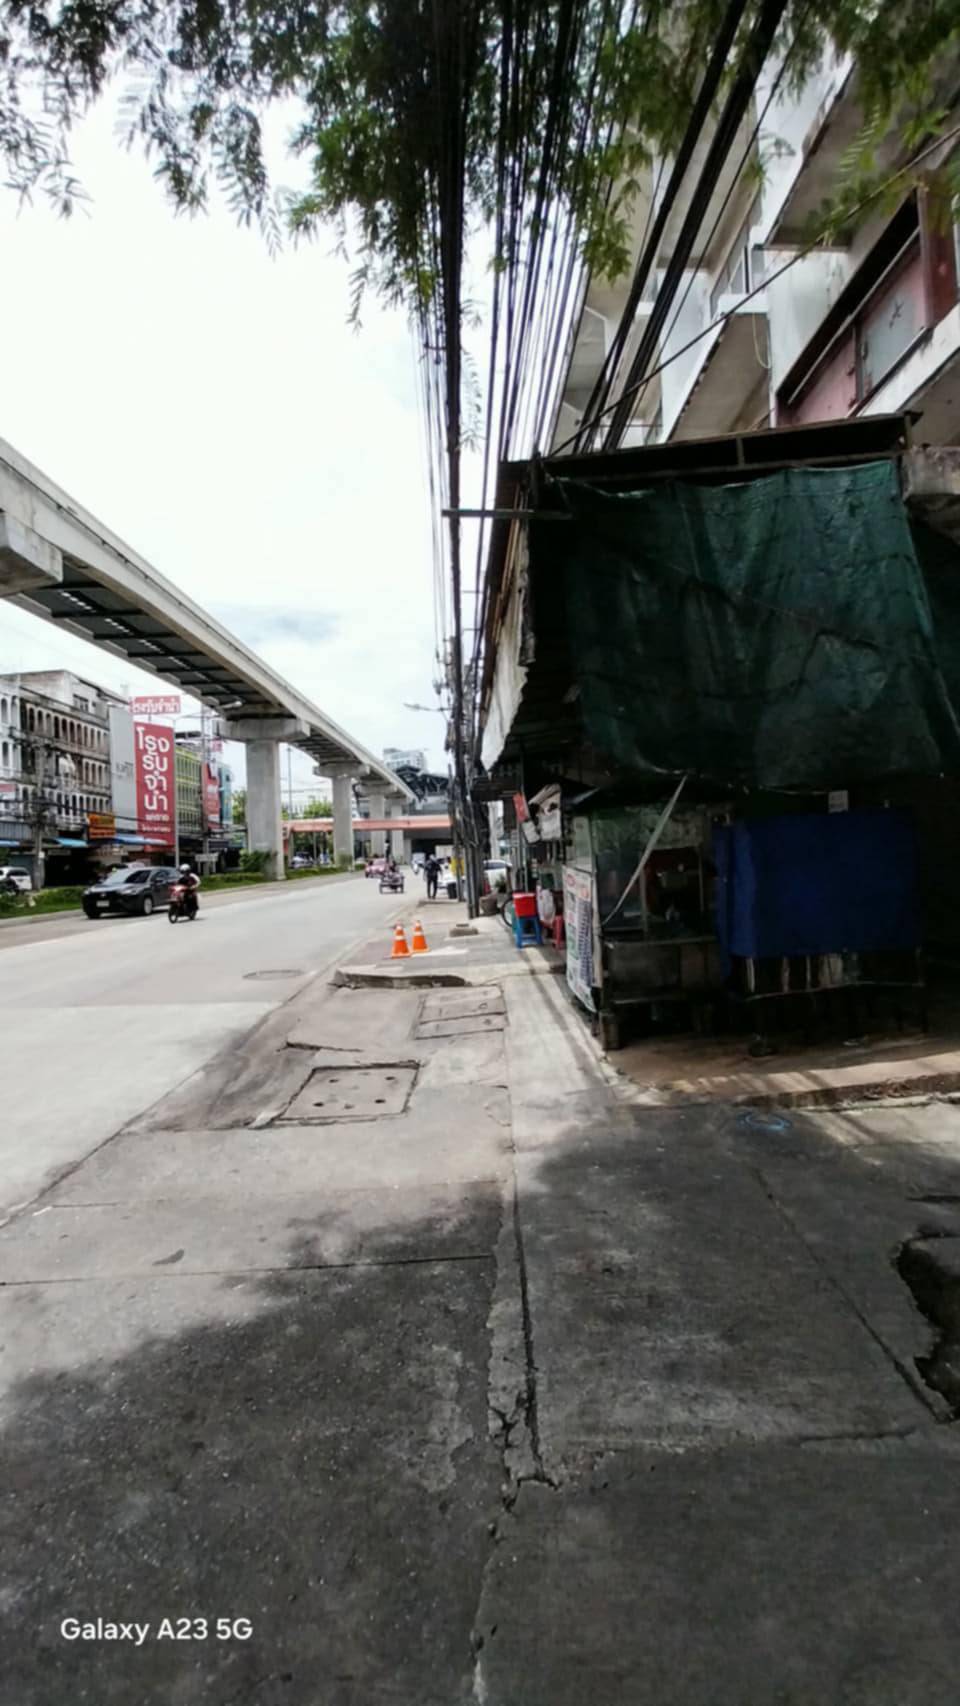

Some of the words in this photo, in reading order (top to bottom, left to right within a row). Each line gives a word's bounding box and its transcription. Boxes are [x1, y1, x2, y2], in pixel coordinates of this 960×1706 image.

[136, 726, 170, 753] โรง
[142, 750, 168, 772] รับ
[143, 770, 168, 791] จำ
[143, 790, 168, 810] นำ
